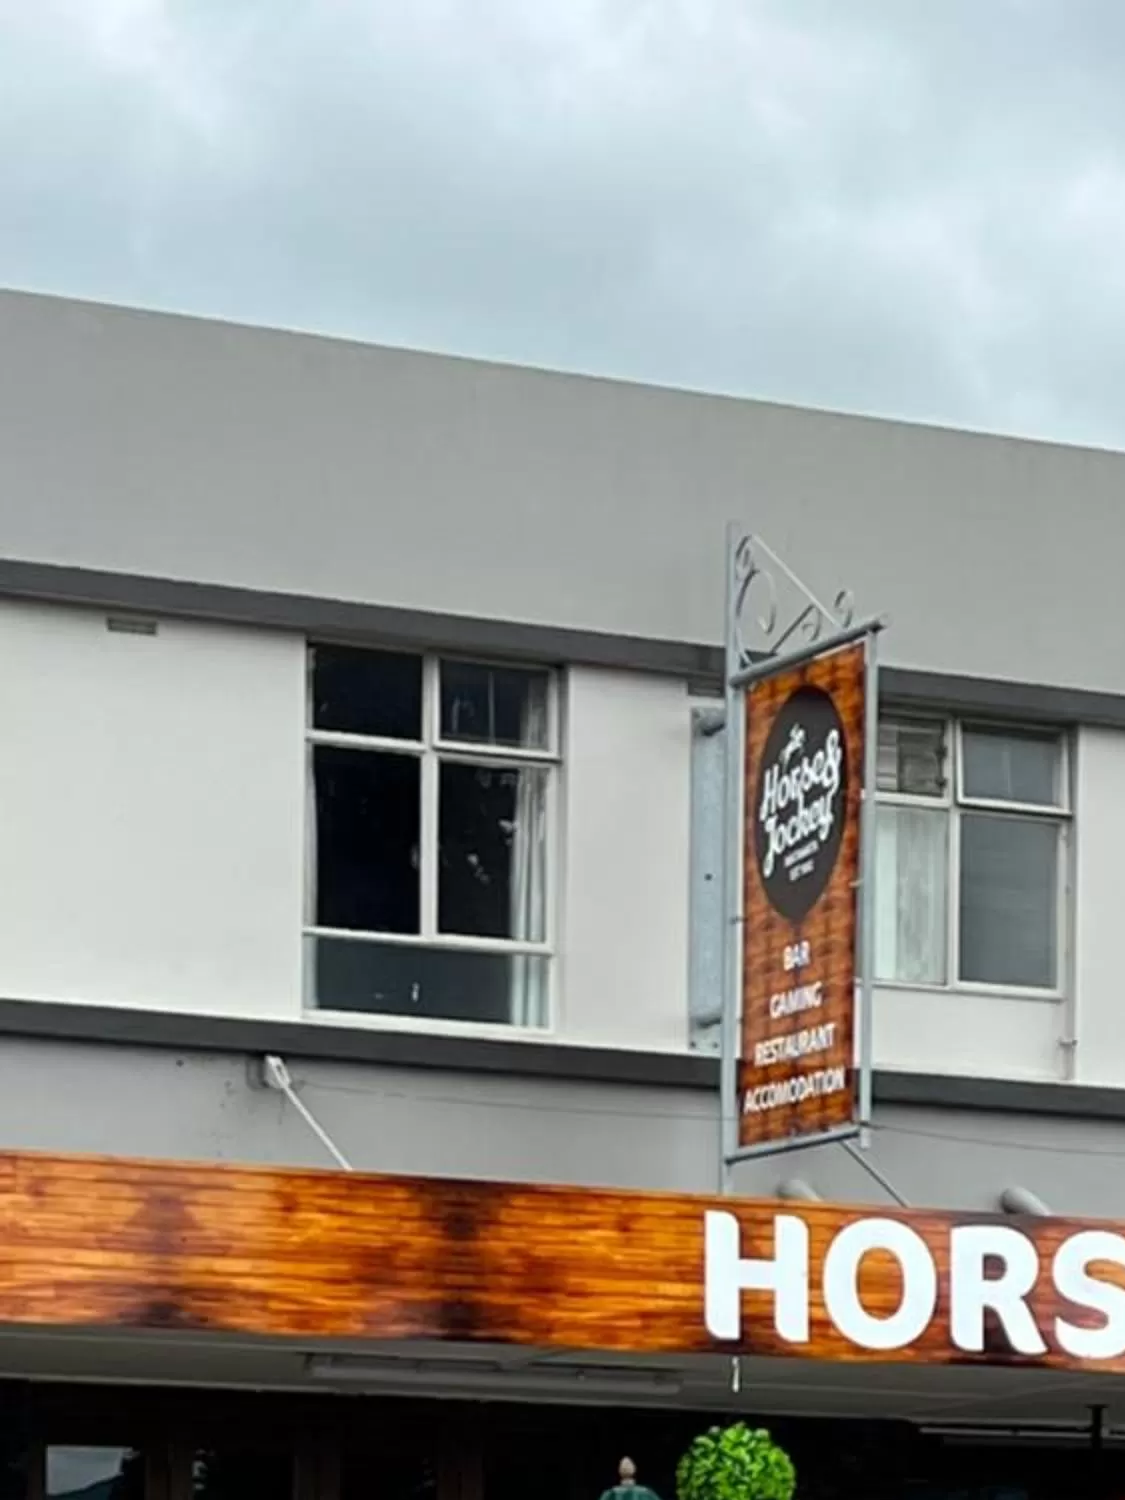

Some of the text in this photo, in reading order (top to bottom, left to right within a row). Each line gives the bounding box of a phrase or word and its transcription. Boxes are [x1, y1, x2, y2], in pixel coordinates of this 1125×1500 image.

[763, 794, 834, 878] Jockey
[783, 940, 810, 971] BAR
[769, 981, 822, 1019] GAMING
[754, 1022, 837, 1067] RESTAURANT
[744, 1066, 846, 1115] ACCOMODATION
